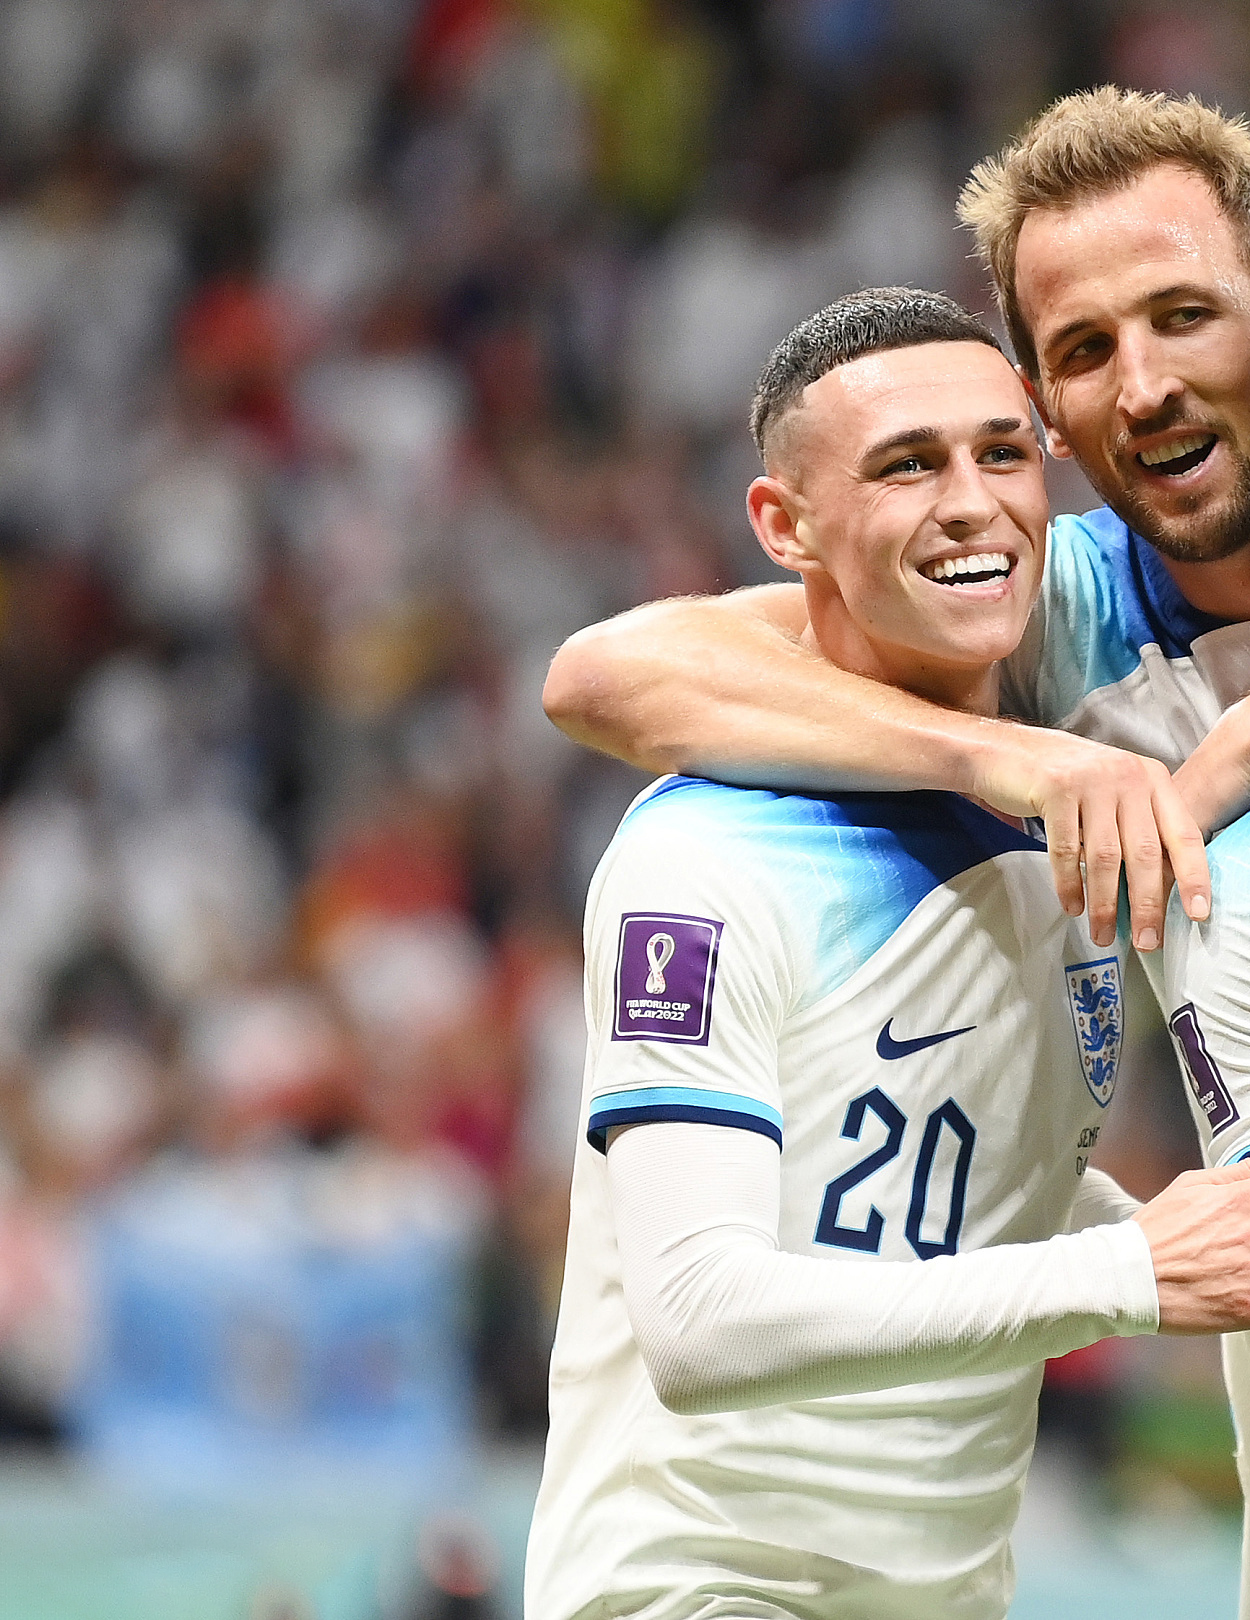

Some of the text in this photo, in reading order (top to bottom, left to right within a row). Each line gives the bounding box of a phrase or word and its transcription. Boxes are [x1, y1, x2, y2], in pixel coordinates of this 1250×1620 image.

[639, 999, 671, 1010] WORLD
[671, 1002, 691, 1012] CUP
[812, 1084, 977, 1261] 20
